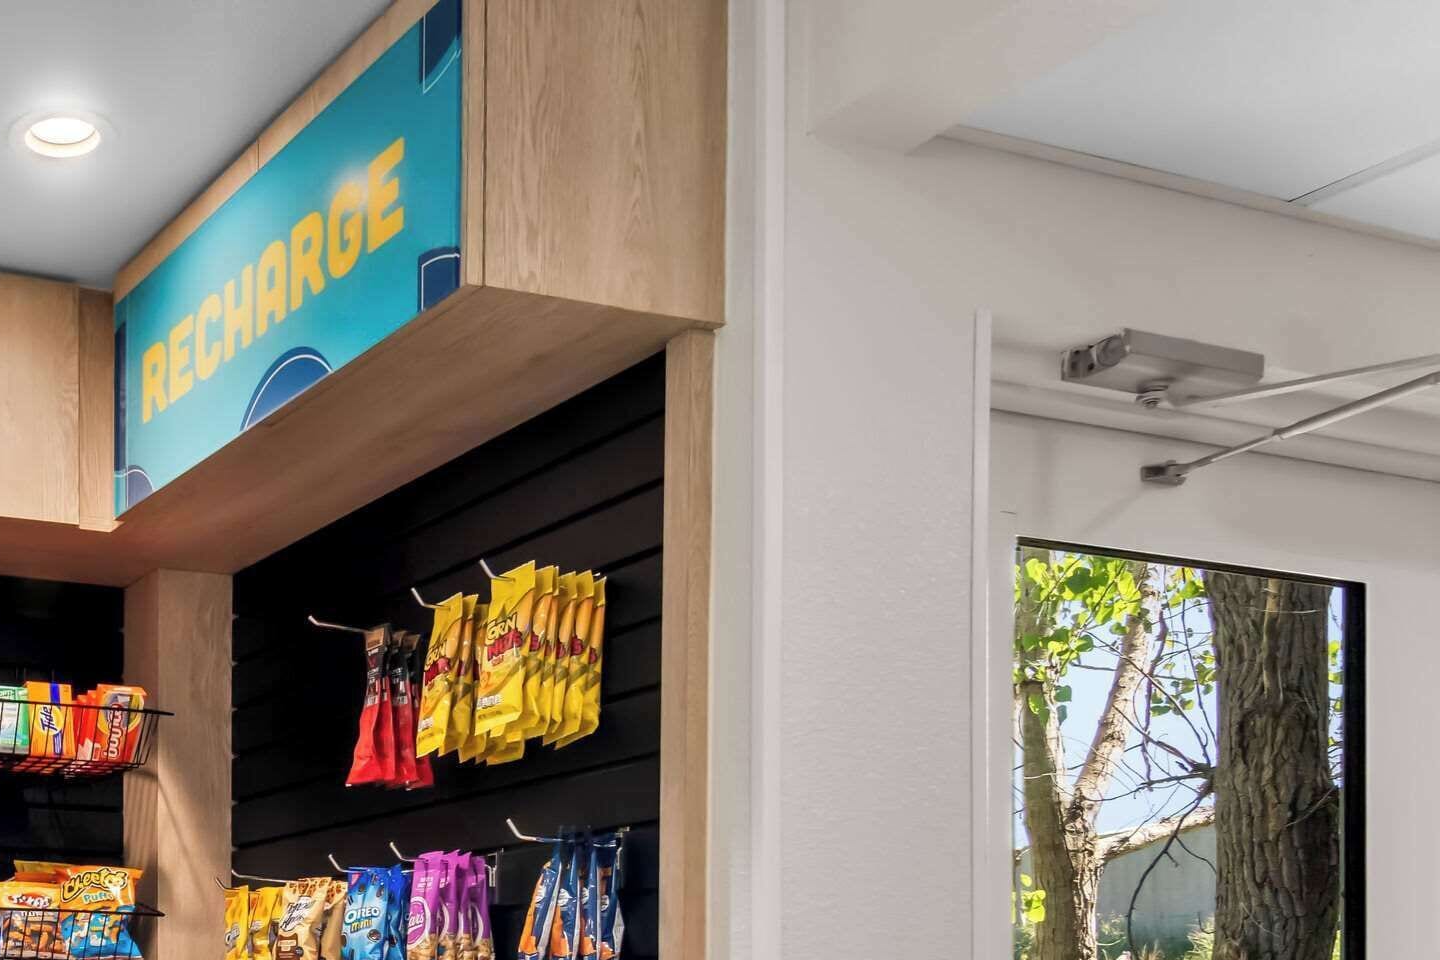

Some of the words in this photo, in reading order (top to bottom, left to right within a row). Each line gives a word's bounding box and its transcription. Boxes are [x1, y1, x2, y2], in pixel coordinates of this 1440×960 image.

[142, 136, 405, 424] RECHARGE
[39, 704, 57, 733] Tide
[345, 907, 380, 924] OREO
